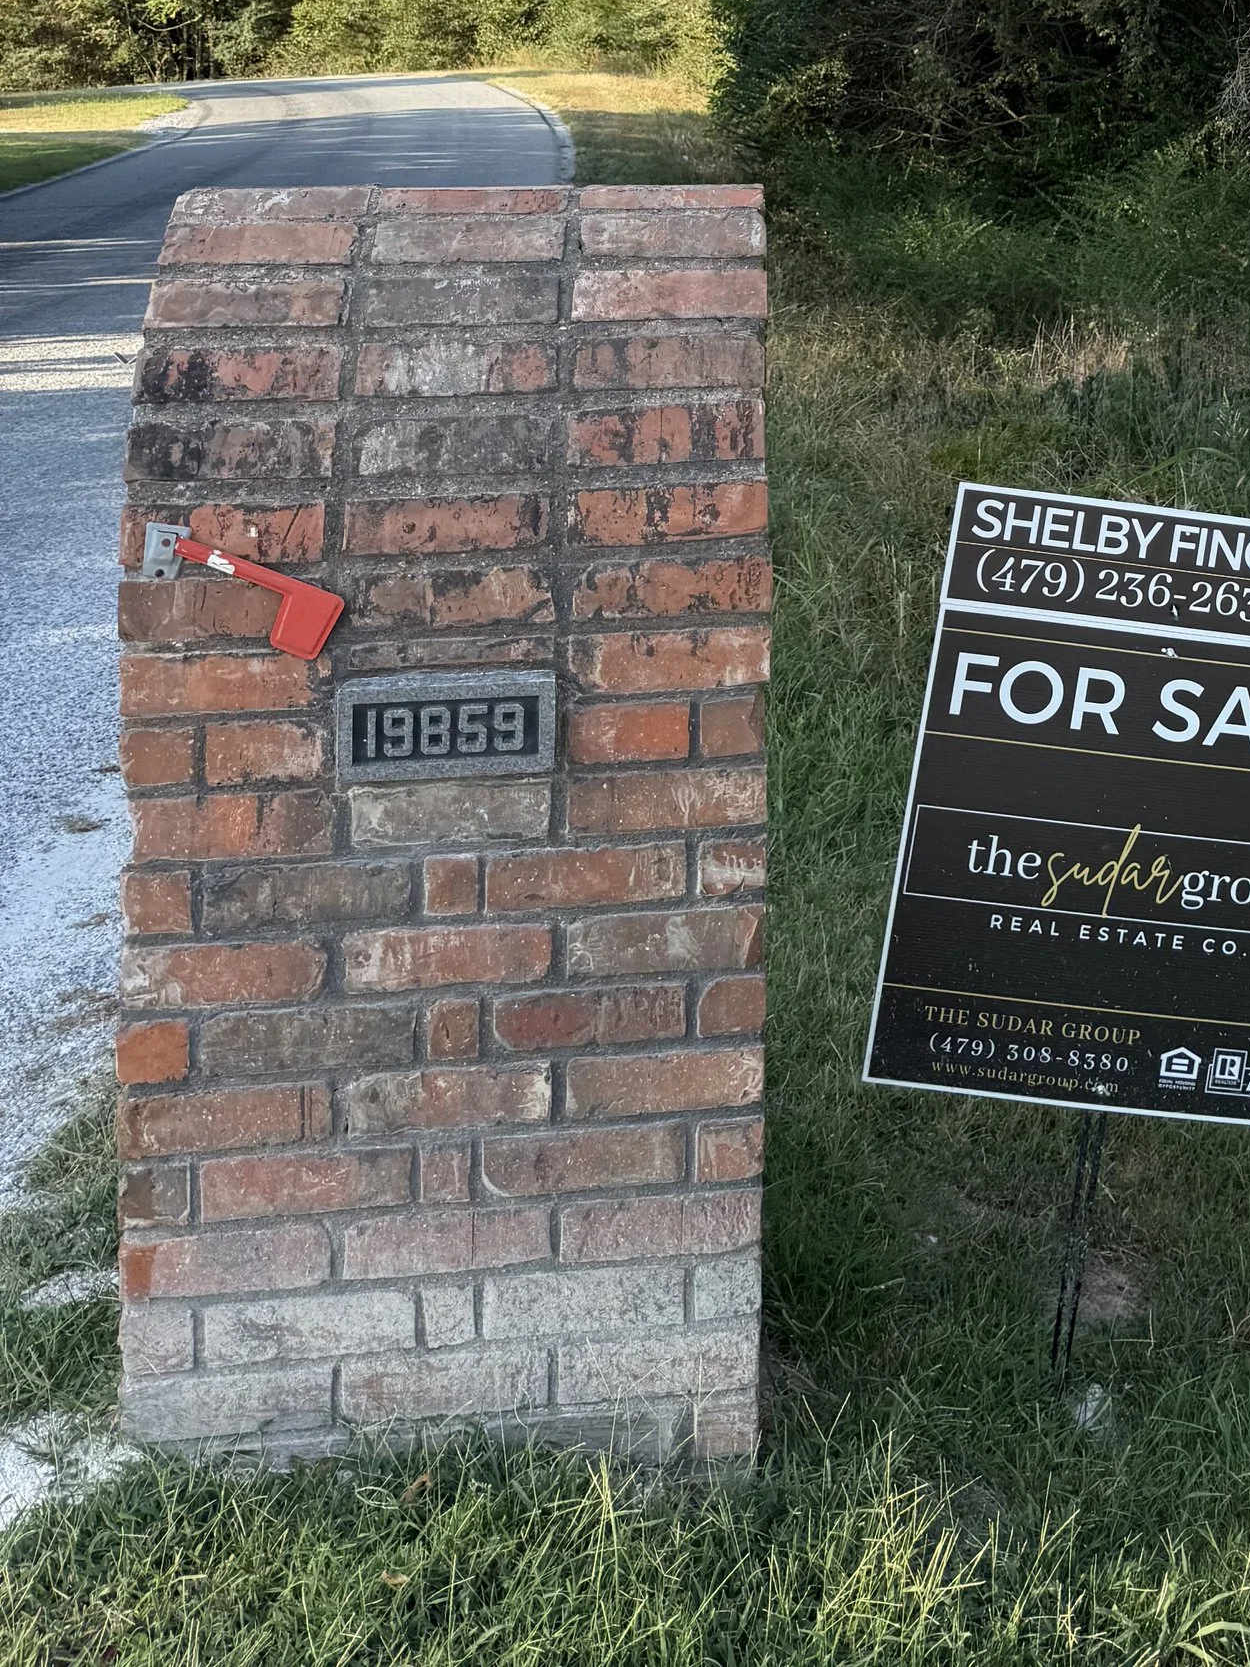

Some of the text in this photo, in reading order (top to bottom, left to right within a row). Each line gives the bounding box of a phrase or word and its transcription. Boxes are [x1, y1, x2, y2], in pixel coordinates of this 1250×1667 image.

[971, 499, 1164, 560] SHELBY
[976, 548, 1085, 603] (479)
[948, 652, 1126, 735] FOR
[367, 703, 525, 758] 19859
[990, 914, 1247, 957] REAL ESTATE CO.
[924, 1005, 1141, 1046] THE SUDAR GROUP
[929, 1032, 1129, 1072] (479) 308-8380
